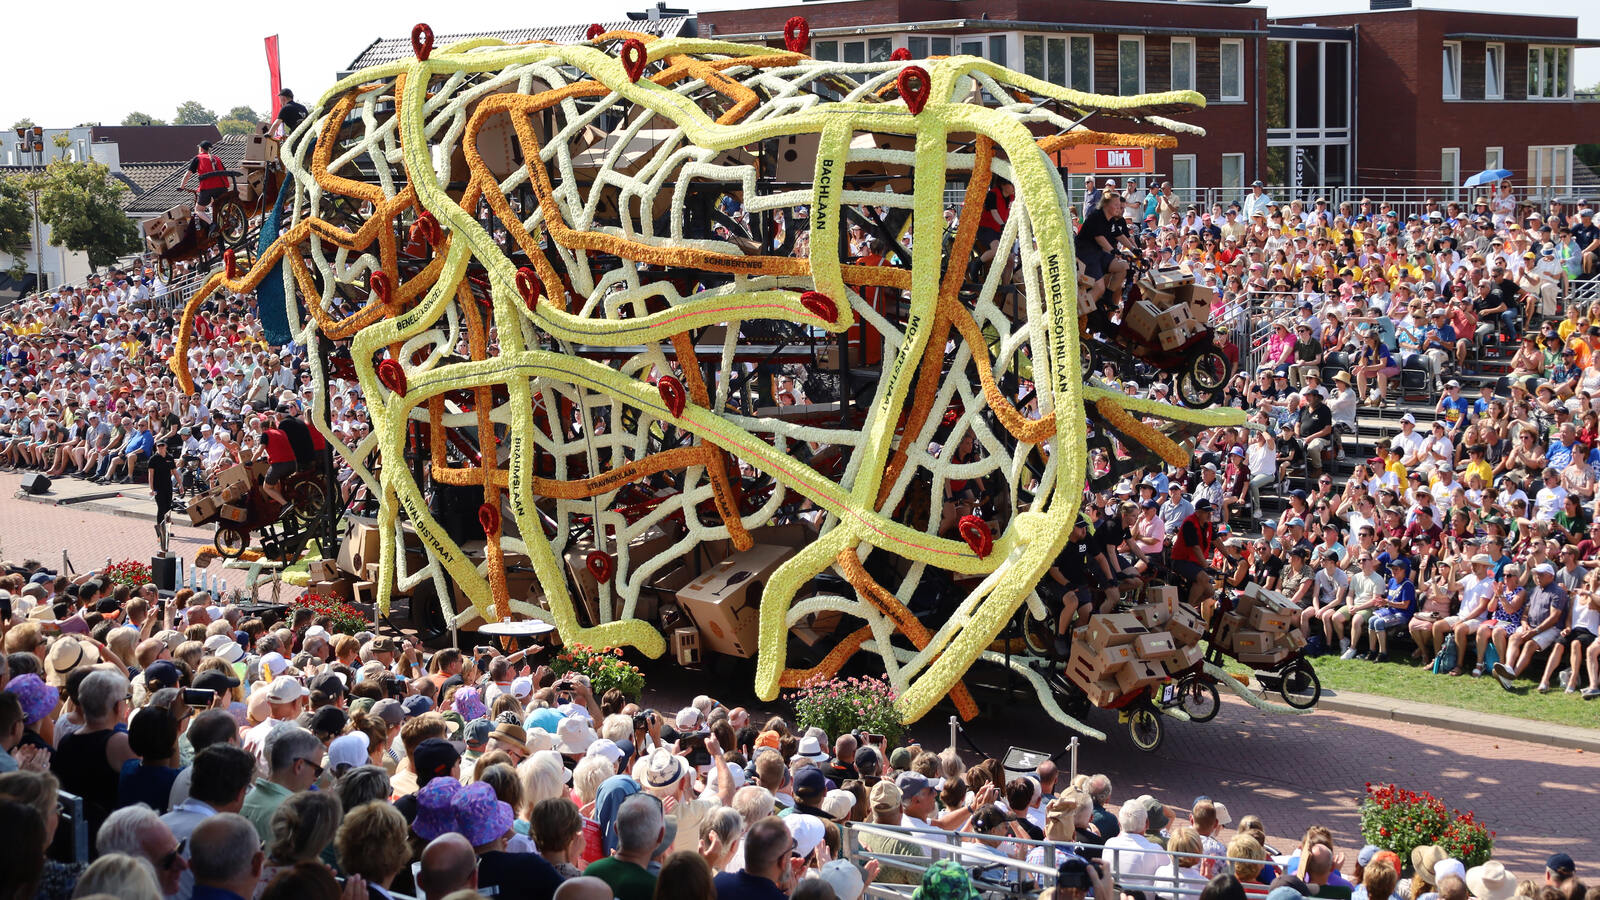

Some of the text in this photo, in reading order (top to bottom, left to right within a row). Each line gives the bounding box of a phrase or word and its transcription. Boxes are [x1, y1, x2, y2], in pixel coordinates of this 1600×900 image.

[816, 159, 834, 230] BACHLAAN
[1107, 150, 1131, 167] Dirk
[704, 256, 762, 269] SCHUBERTWEG
[1047, 253, 1068, 393] MENDELSSOHNLAAN
[882, 315, 921, 414] MOZARTSTRAAT
[513, 437, 525, 517] BRAHMSLAAN
